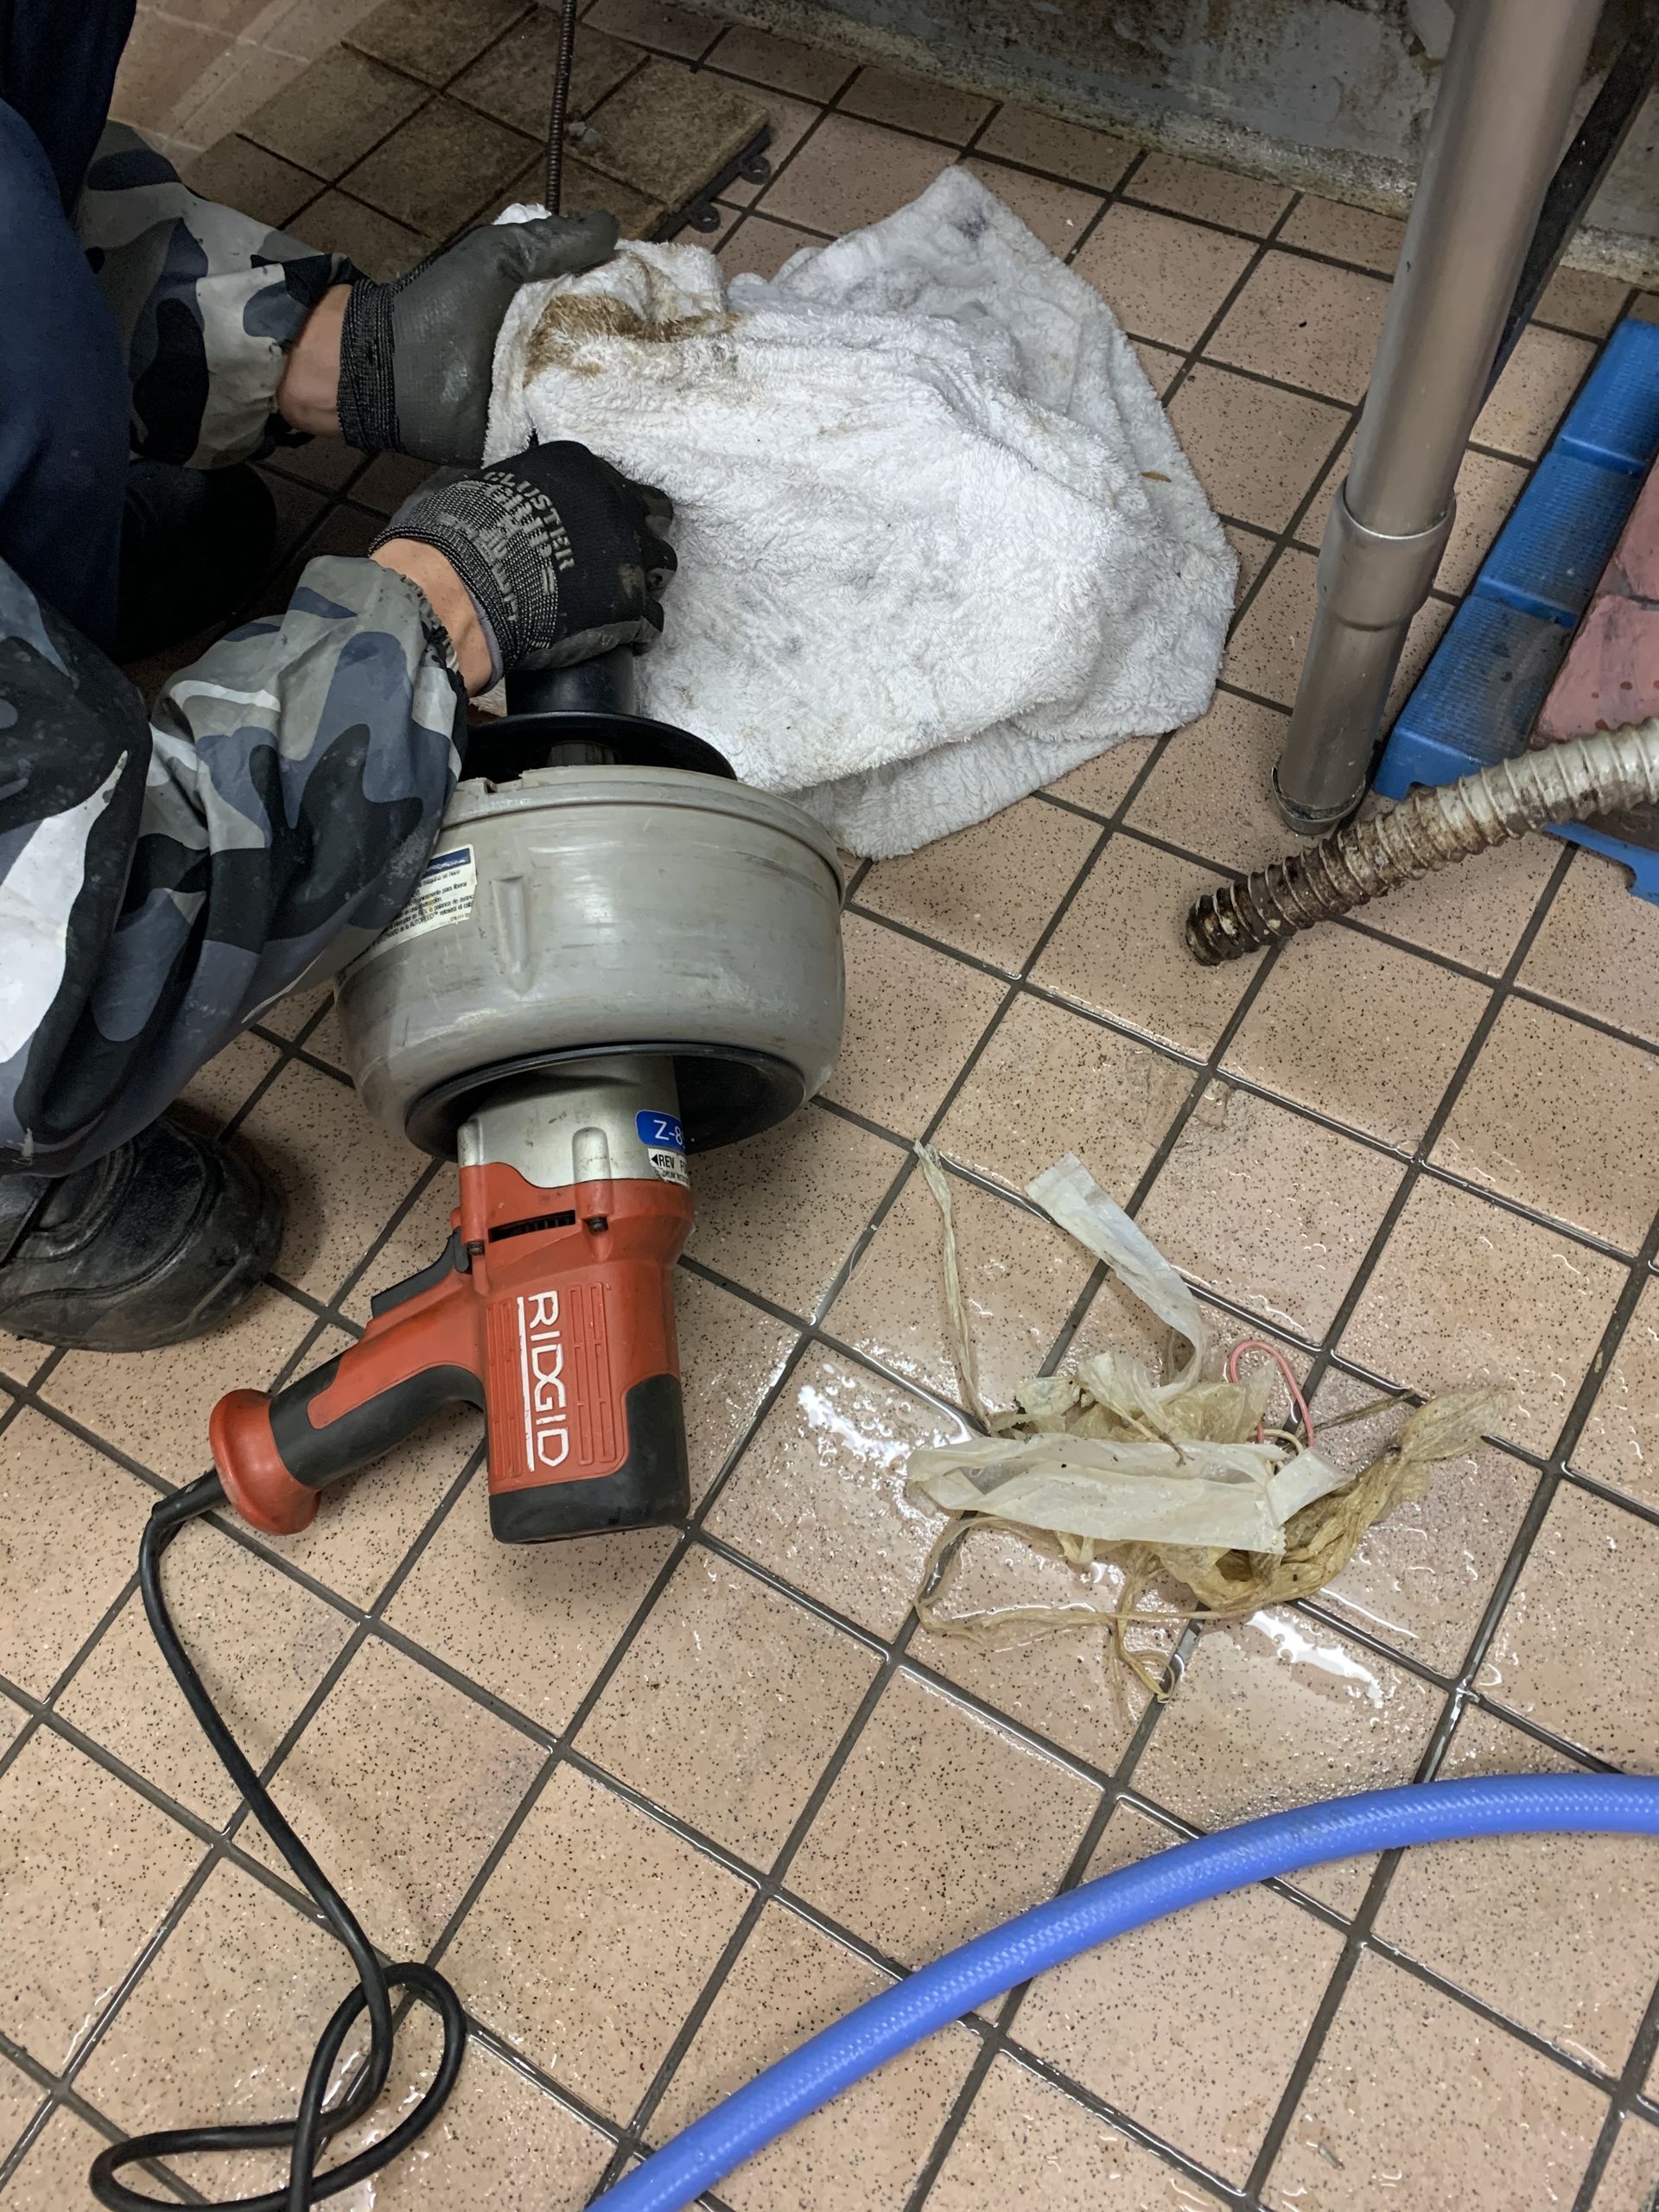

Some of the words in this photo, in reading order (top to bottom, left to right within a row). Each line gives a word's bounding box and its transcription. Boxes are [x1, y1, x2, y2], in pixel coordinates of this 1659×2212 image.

[653, 1119, 685, 1149] Z-8
[658, 1154, 674, 1169] REV
[528, 1290, 570, 1467] RIDGID
